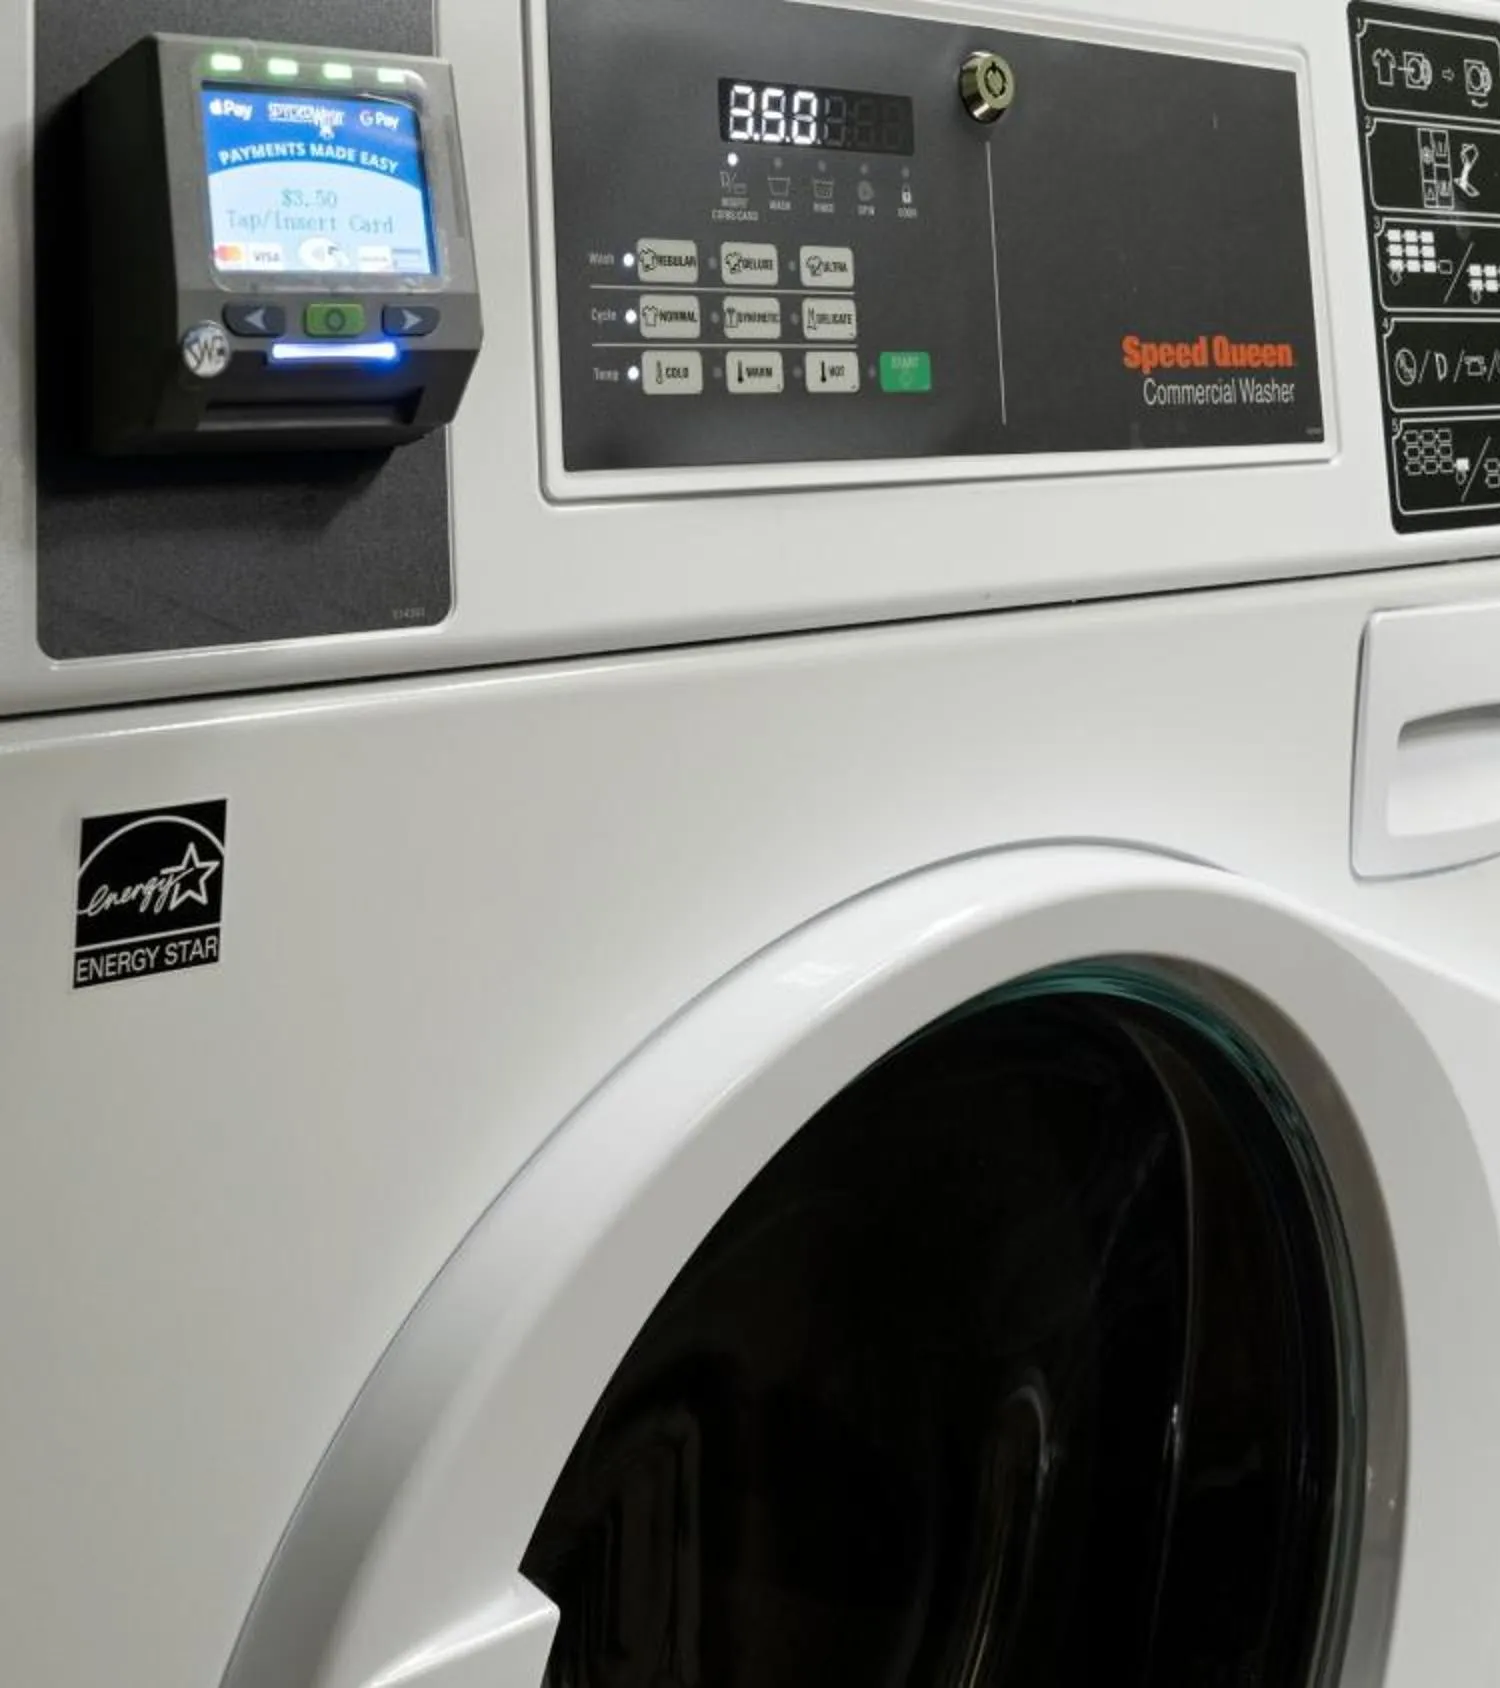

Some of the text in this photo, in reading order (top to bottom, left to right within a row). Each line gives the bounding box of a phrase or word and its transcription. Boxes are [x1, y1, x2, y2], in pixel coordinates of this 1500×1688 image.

[375, 111, 400, 130] Pay
[218, 142, 398, 173] PAYMENTS MADE EASY
[281, 188, 338, 209] $3.50
[226, 209, 394, 233] Tap/Insert Card
[254, 251, 280, 263] VISA
[656, 254, 697, 267] REGULAR
[741, 258, 774, 271] DELUXE
[823, 260, 848, 273] ULTRA
[659, 310, 698, 323] NORMAL
[816, 313, 853, 325] DELICATE
[1122, 334, 1293, 375] Speed Queen
[665, 367, 689, 379] COLD
[745, 366, 773, 378] WARM
[829, 365, 845, 377] HOT
[1143, 377, 1295, 405] Commercial Washer
[76, 935, 218, 982] ENERGY STAR
